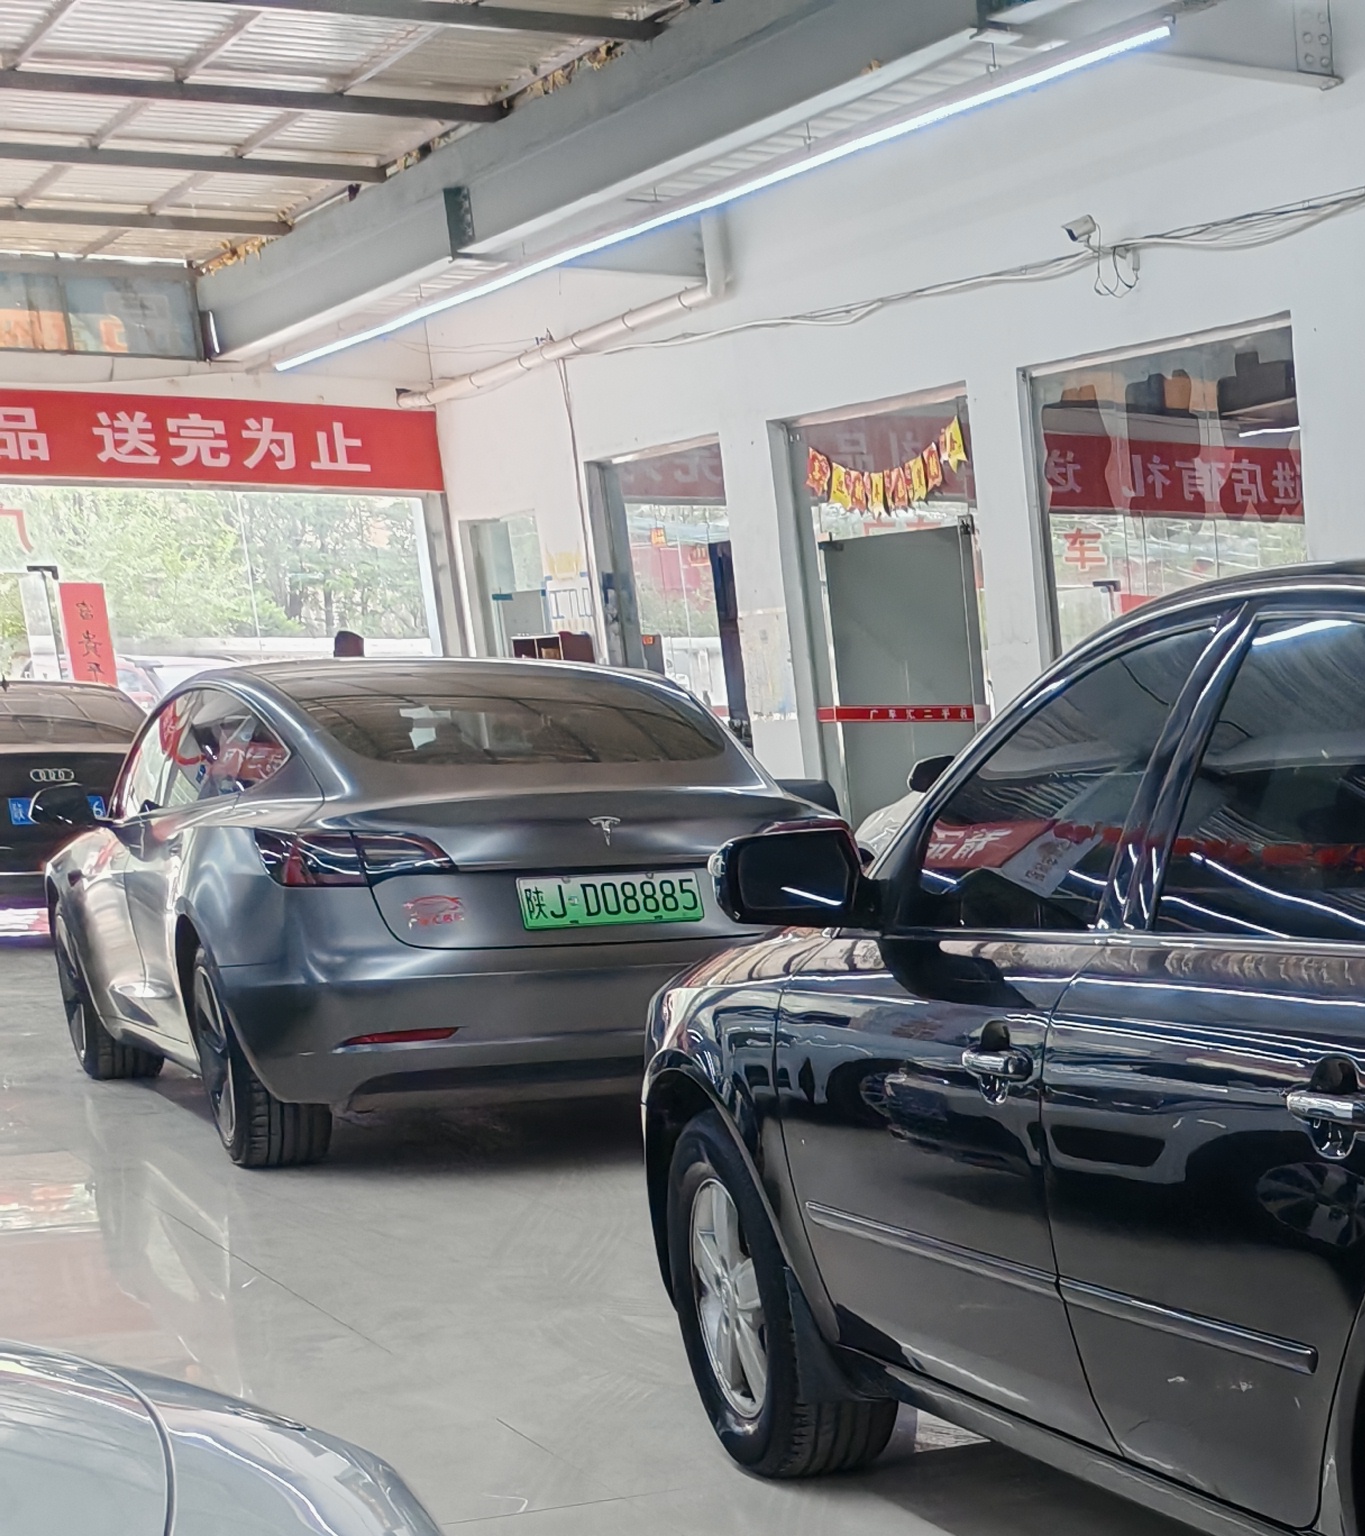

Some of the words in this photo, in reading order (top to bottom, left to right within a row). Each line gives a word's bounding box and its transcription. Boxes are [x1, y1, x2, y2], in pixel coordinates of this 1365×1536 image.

[92, 410, 372, 473] 送完为止
[1062, 527, 1106, 570] 车
